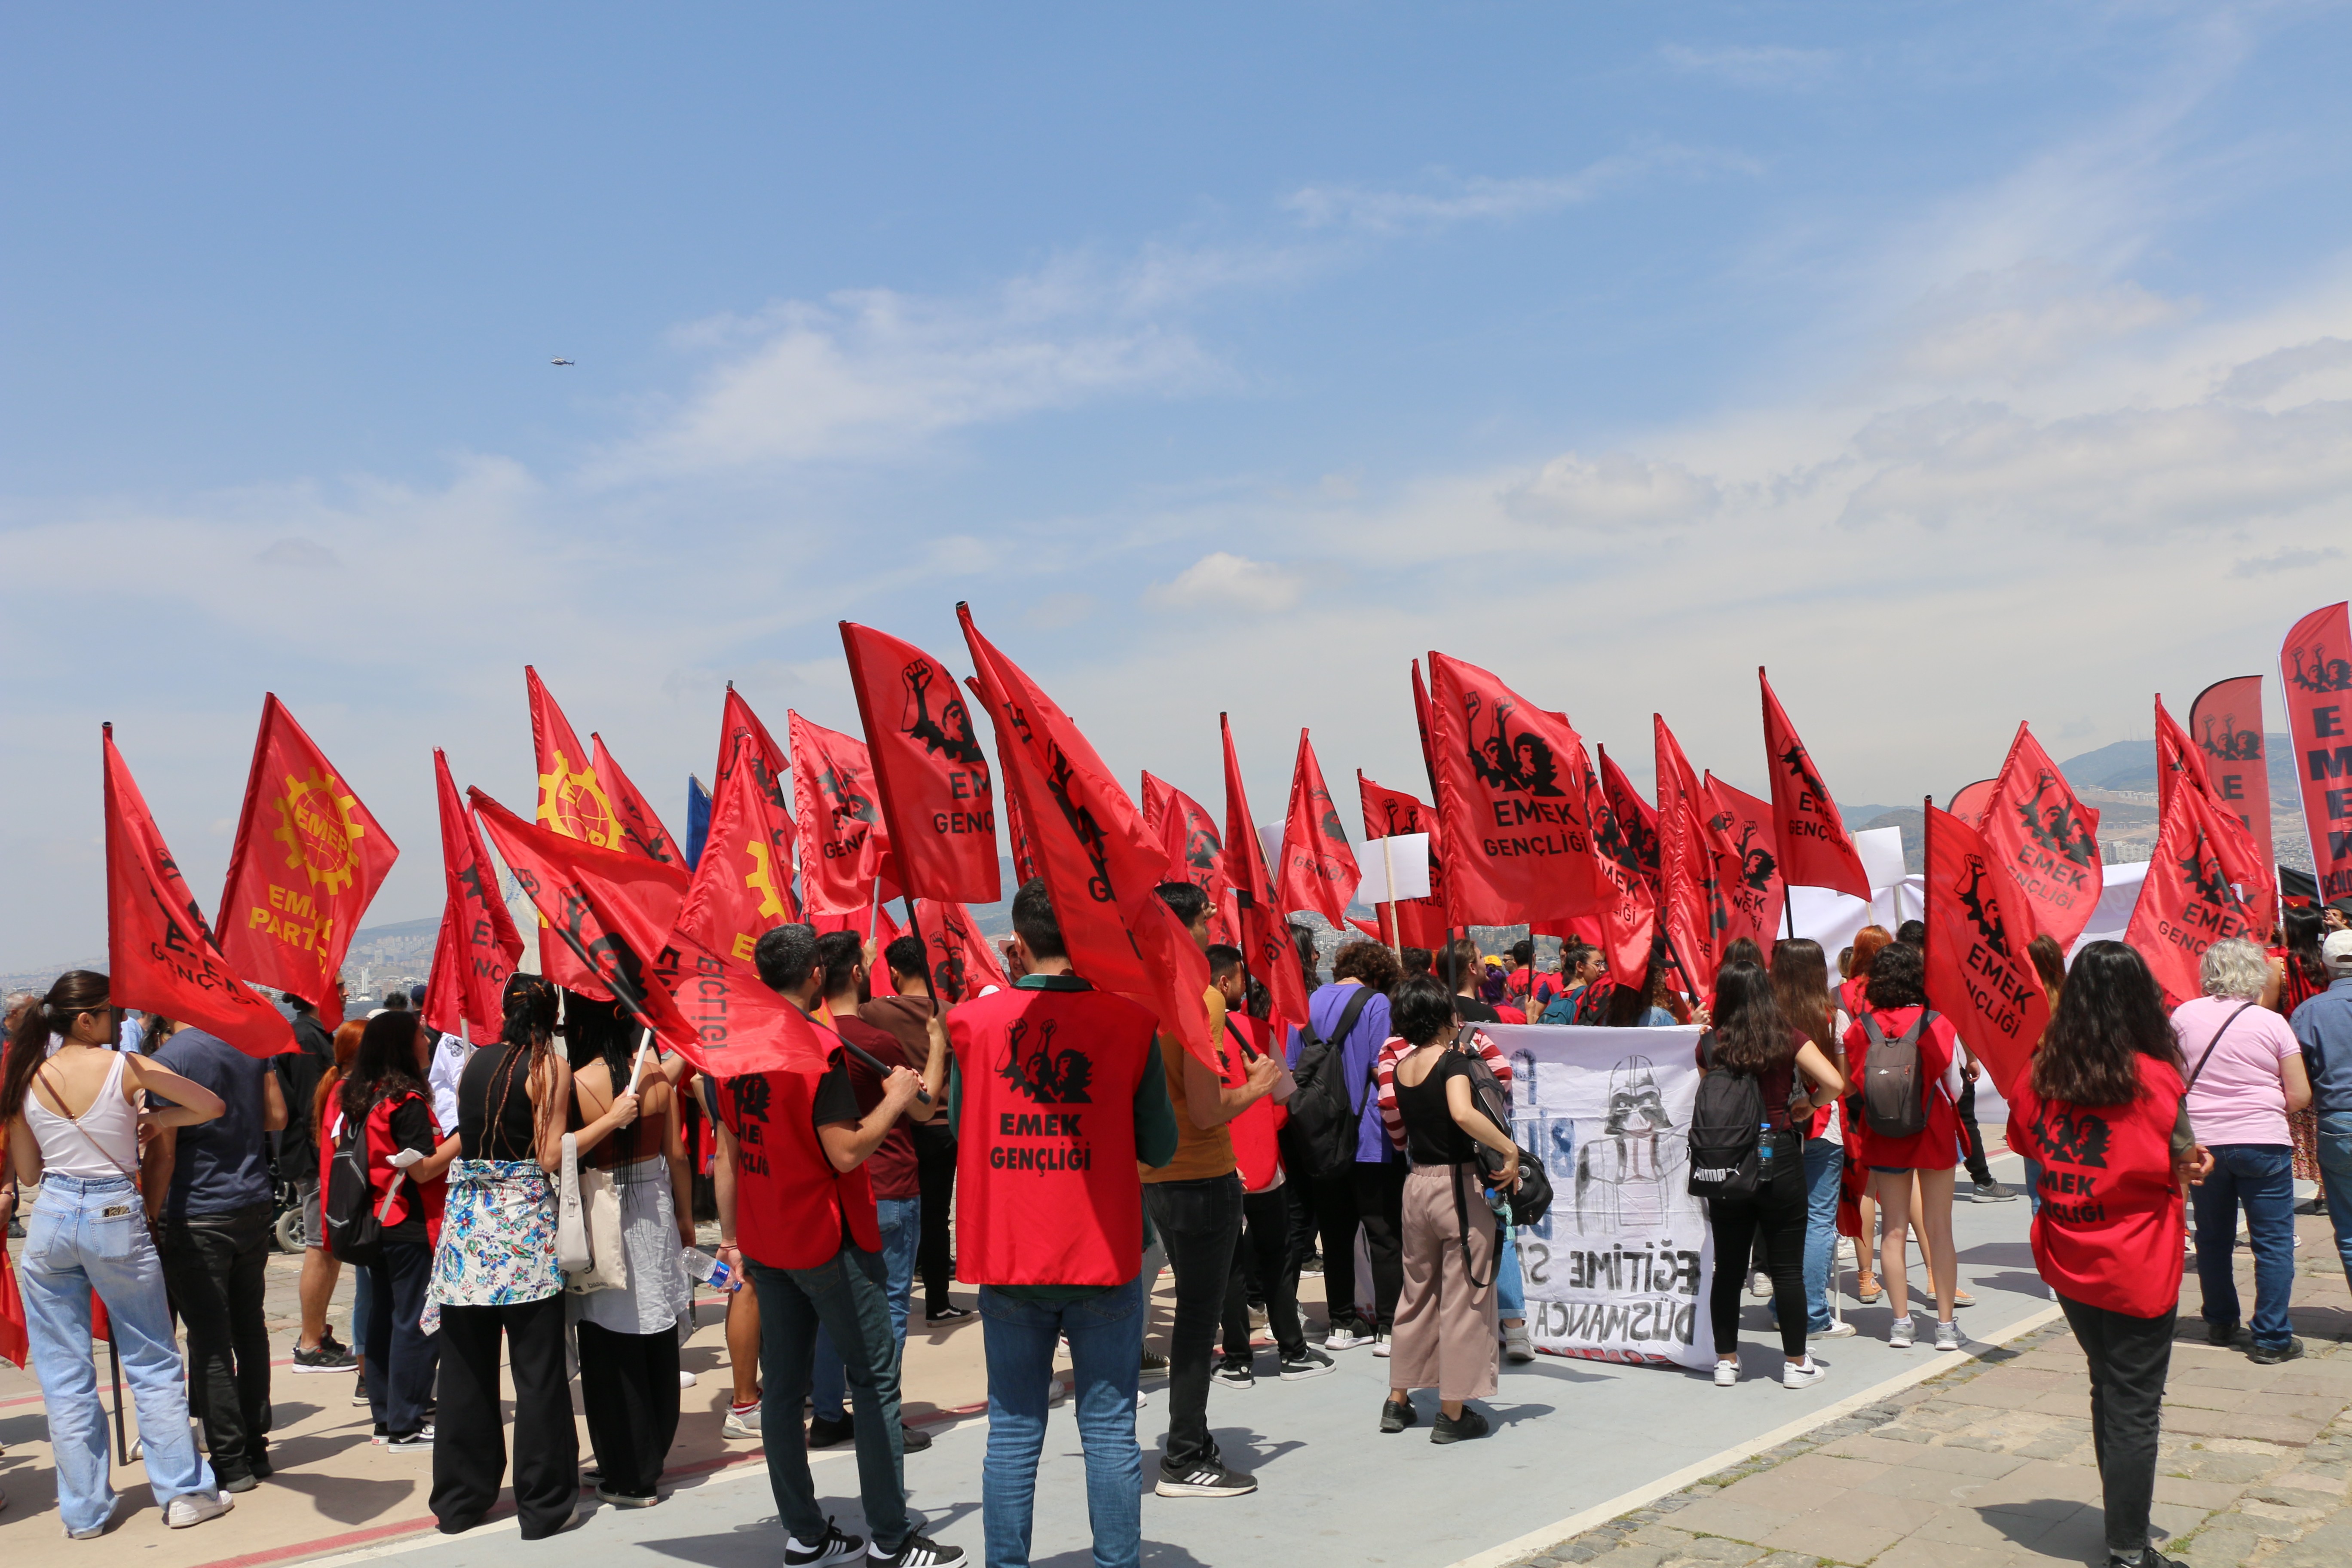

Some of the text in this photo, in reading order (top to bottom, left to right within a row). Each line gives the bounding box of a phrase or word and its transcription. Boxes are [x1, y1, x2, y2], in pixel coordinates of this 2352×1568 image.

[1493, 799, 1581, 827] EMEK
[294, 805, 348, 854] EMEP
[1483, 829, 1589, 856] GENÇLİĞİ
[2018, 844, 2088, 892] EMEK
[1966, 943, 2036, 1015] EMEK
[1000, 1113, 1082, 1136] EMEK
[990, 1141, 1090, 1177] GENÇLİĞİ
[1694, 1167, 1726, 1182] PUMA
